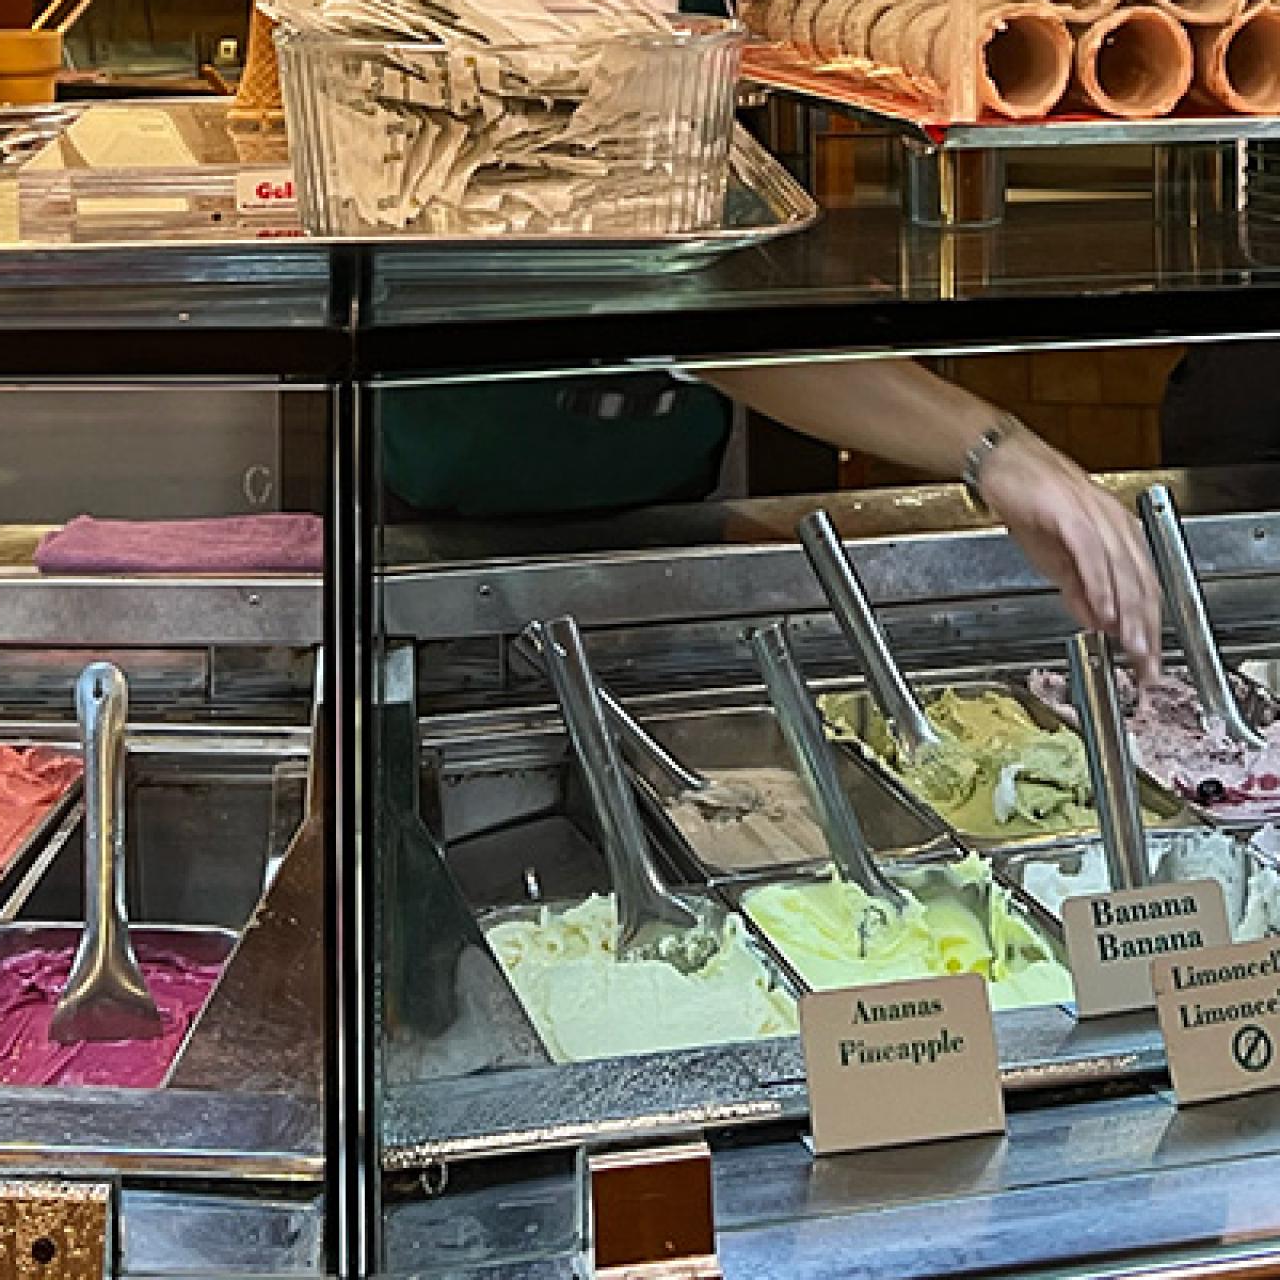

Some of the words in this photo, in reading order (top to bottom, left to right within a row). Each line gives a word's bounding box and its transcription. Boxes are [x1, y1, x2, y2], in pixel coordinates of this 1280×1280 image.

[1090, 894, 1199, 929] Banana
[1097, 927, 1204, 961] Banana
[851, 996, 945, 1026] Ananas
[838, 1031, 965, 1068] Pineapple
